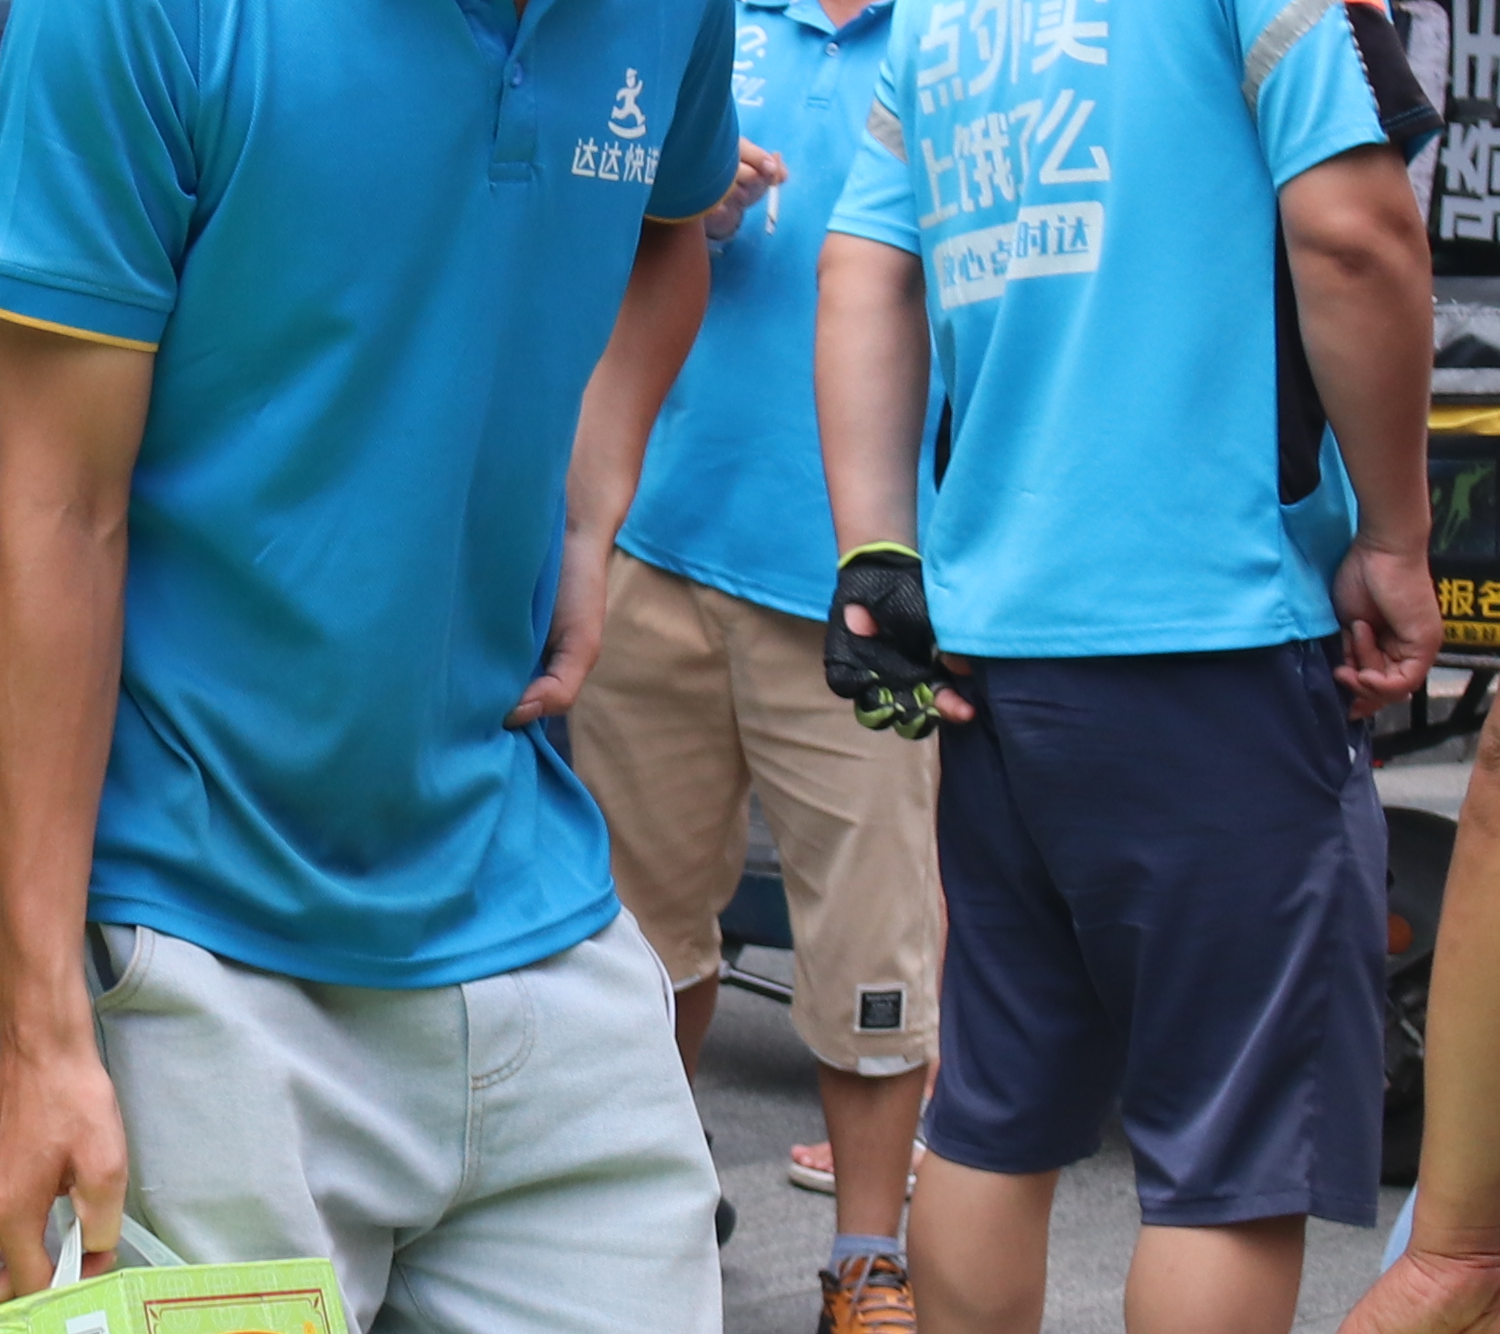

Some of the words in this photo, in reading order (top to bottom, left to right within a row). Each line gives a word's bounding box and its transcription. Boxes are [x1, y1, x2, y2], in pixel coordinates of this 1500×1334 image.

[571, 137, 660, 185] 达达快送
[918, 89, 1112, 231] 上饿了么
